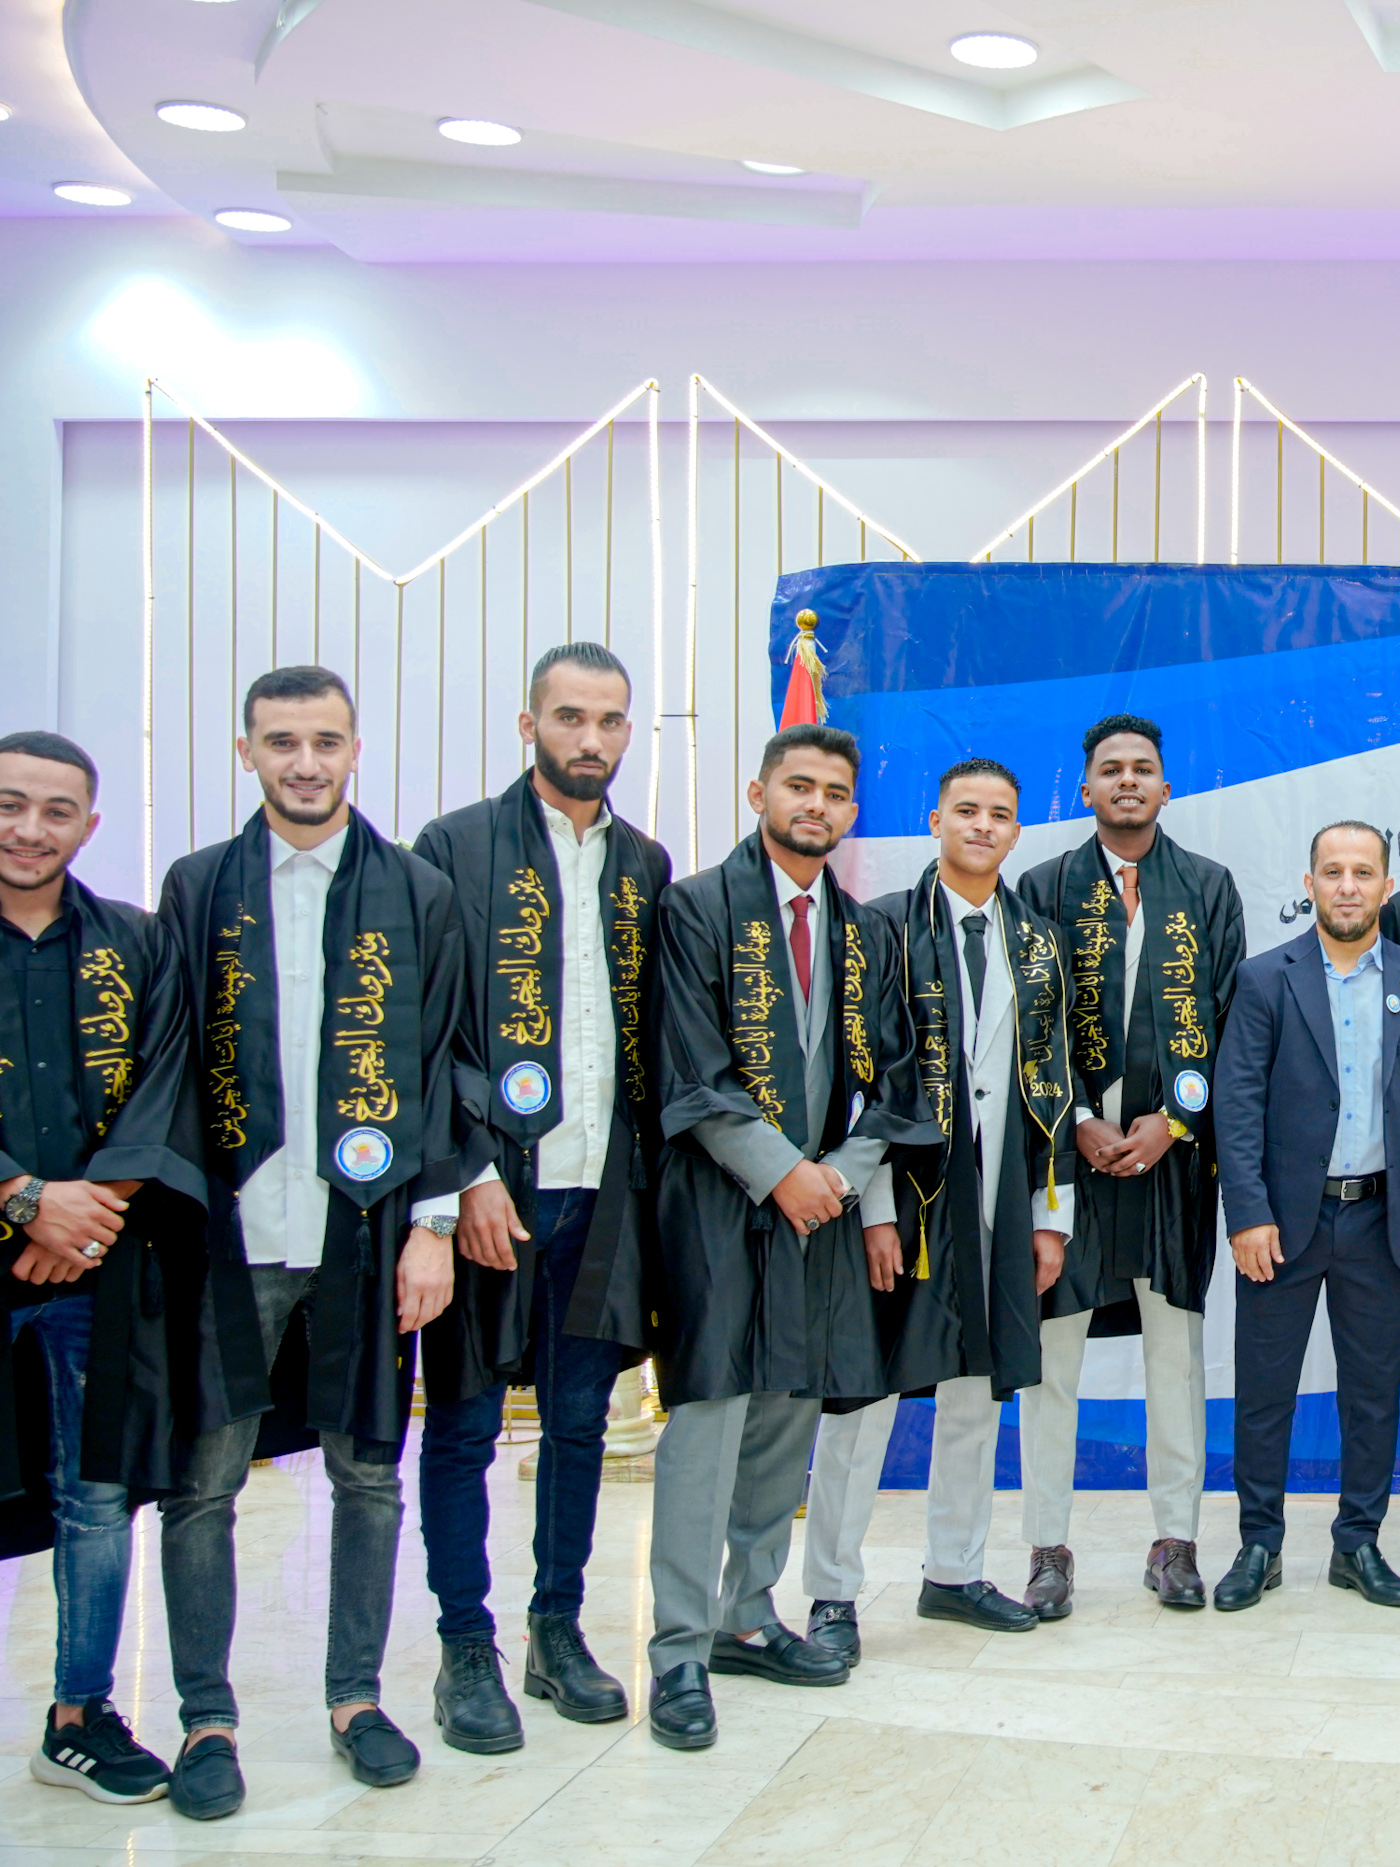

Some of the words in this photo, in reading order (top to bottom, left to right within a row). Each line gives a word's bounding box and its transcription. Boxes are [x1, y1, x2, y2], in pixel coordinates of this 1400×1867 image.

[499, 867, 551, 955] مبروك
[1016, 920, 1055, 963] خريج
[1073, 916, 1116, 969] الشهيدة
[1162, 911, 1199, 984] مبروك
[215, 950, 257, 1014] الشهيدة
[337, 931, 393, 1026] مبروك
[612, 920, 648, 982] الشهيدة
[844, 922, 867, 1002] مبروك
[80, 947, 135, 1043] مبروك
[496, 958, 552, 1046] التخرج
[732, 962, 785, 1022] الشهيدة
[1162, 986, 1208, 1059] التخرج
[334, 1029, 399, 1122] التخرج
[843, 1004, 875, 1083] التخرج
[1031, 1081, 1063, 1099] 2024
